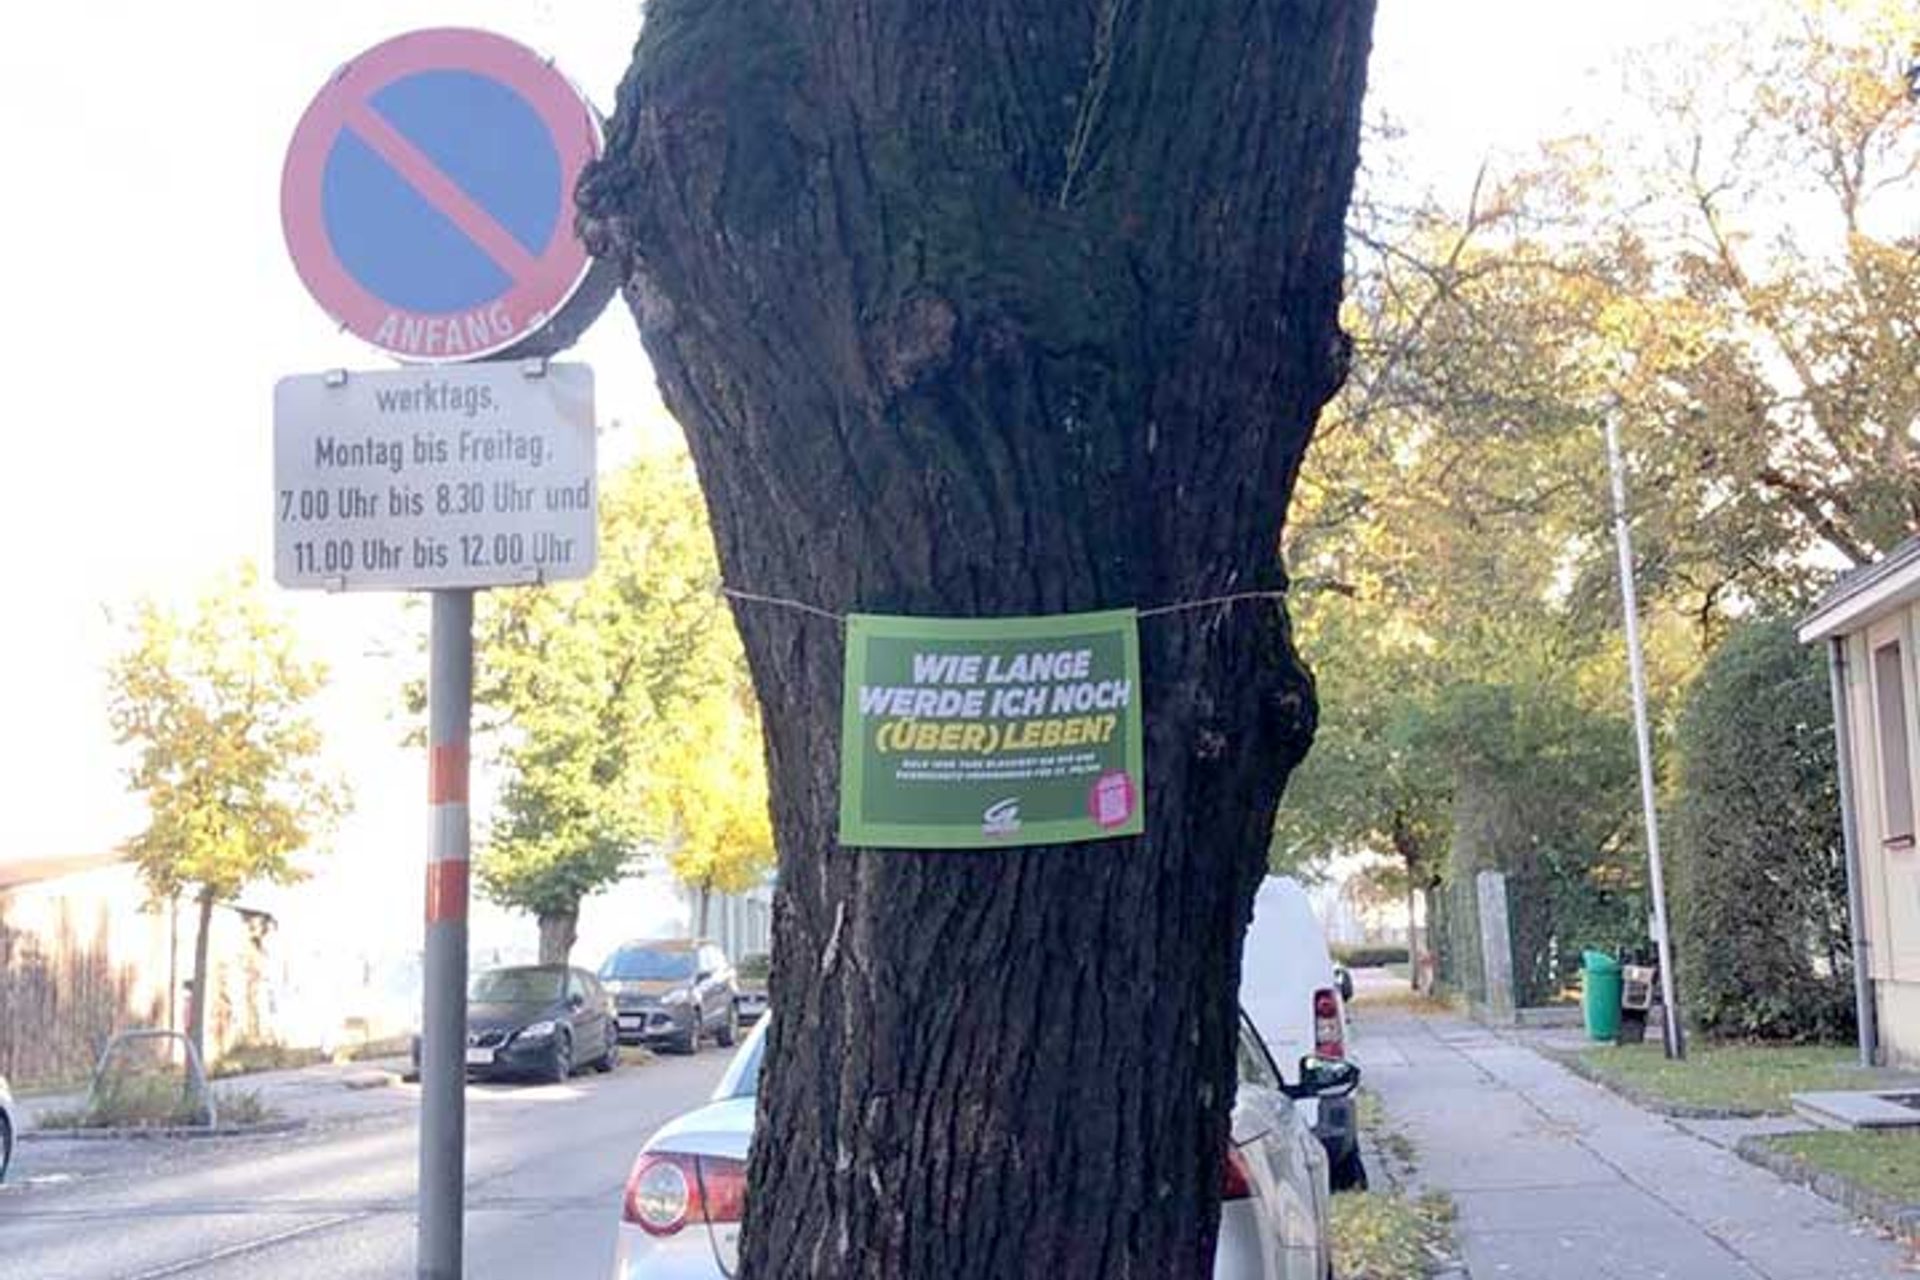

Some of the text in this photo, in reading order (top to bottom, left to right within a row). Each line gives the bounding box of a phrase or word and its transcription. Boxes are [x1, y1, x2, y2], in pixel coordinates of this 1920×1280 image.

[374, 301, 513, 352] ANFANG
[315, 436, 403, 473] Montag
[412, 432, 448, 463] bis
[280, 479, 590, 522] 7.00 Uhr bis 8.30 Uhr und
[294, 533, 575, 572] 11.00 Uhr bis 12.00 Uhr
[912, 649, 1091, 683] WIE LANGE
[859, 680, 1131, 717] WERDE ICH NOCH
